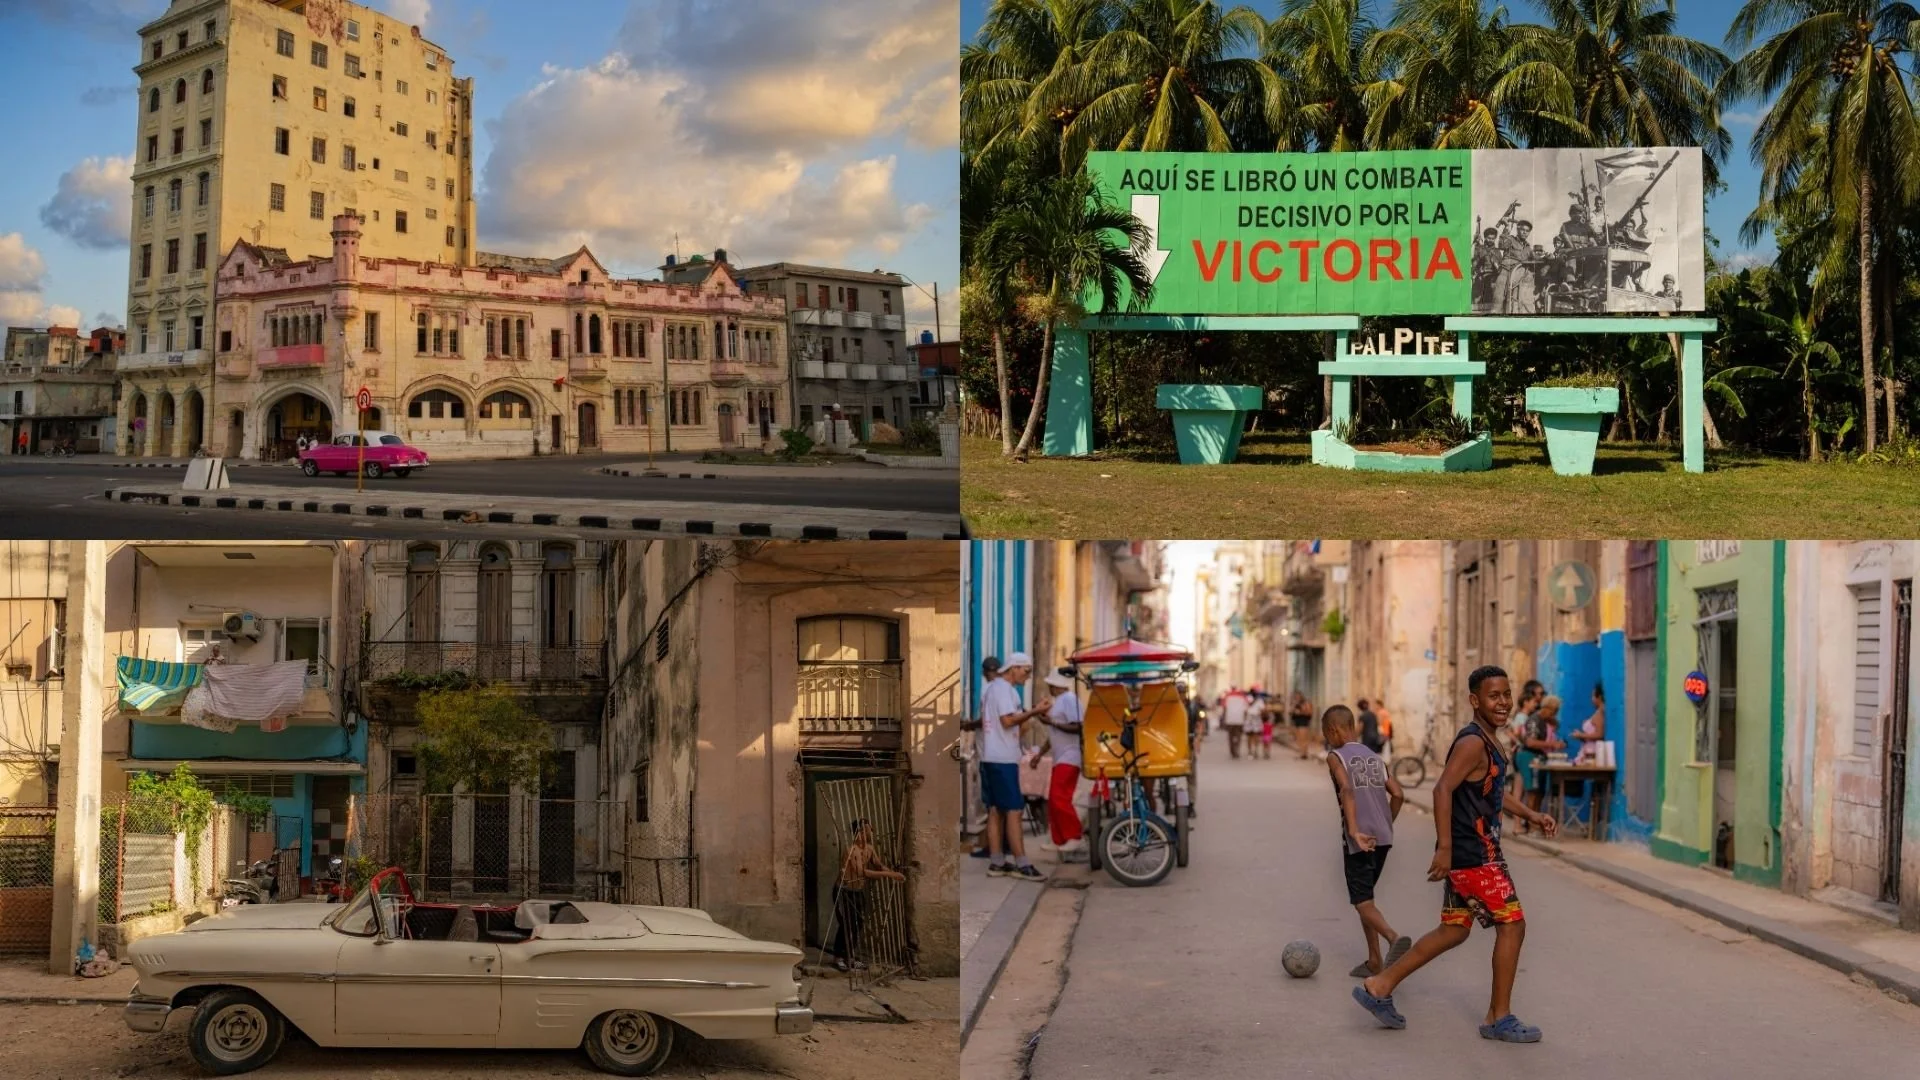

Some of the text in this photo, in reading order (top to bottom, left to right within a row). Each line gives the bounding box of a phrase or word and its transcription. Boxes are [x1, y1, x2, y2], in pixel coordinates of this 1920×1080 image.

[1120, 164, 1463, 192] AQUÍ SE LIBRÓ UN COMBATE
[1238, 202, 1449, 228] DECISIVO POR LA
[1191, 237, 1464, 283] VICTORIA
[1350, 327, 1455, 356] PALPITE
[1684, 677, 1706, 695] OPEN
[1349, 755, 1386, 789] 23
